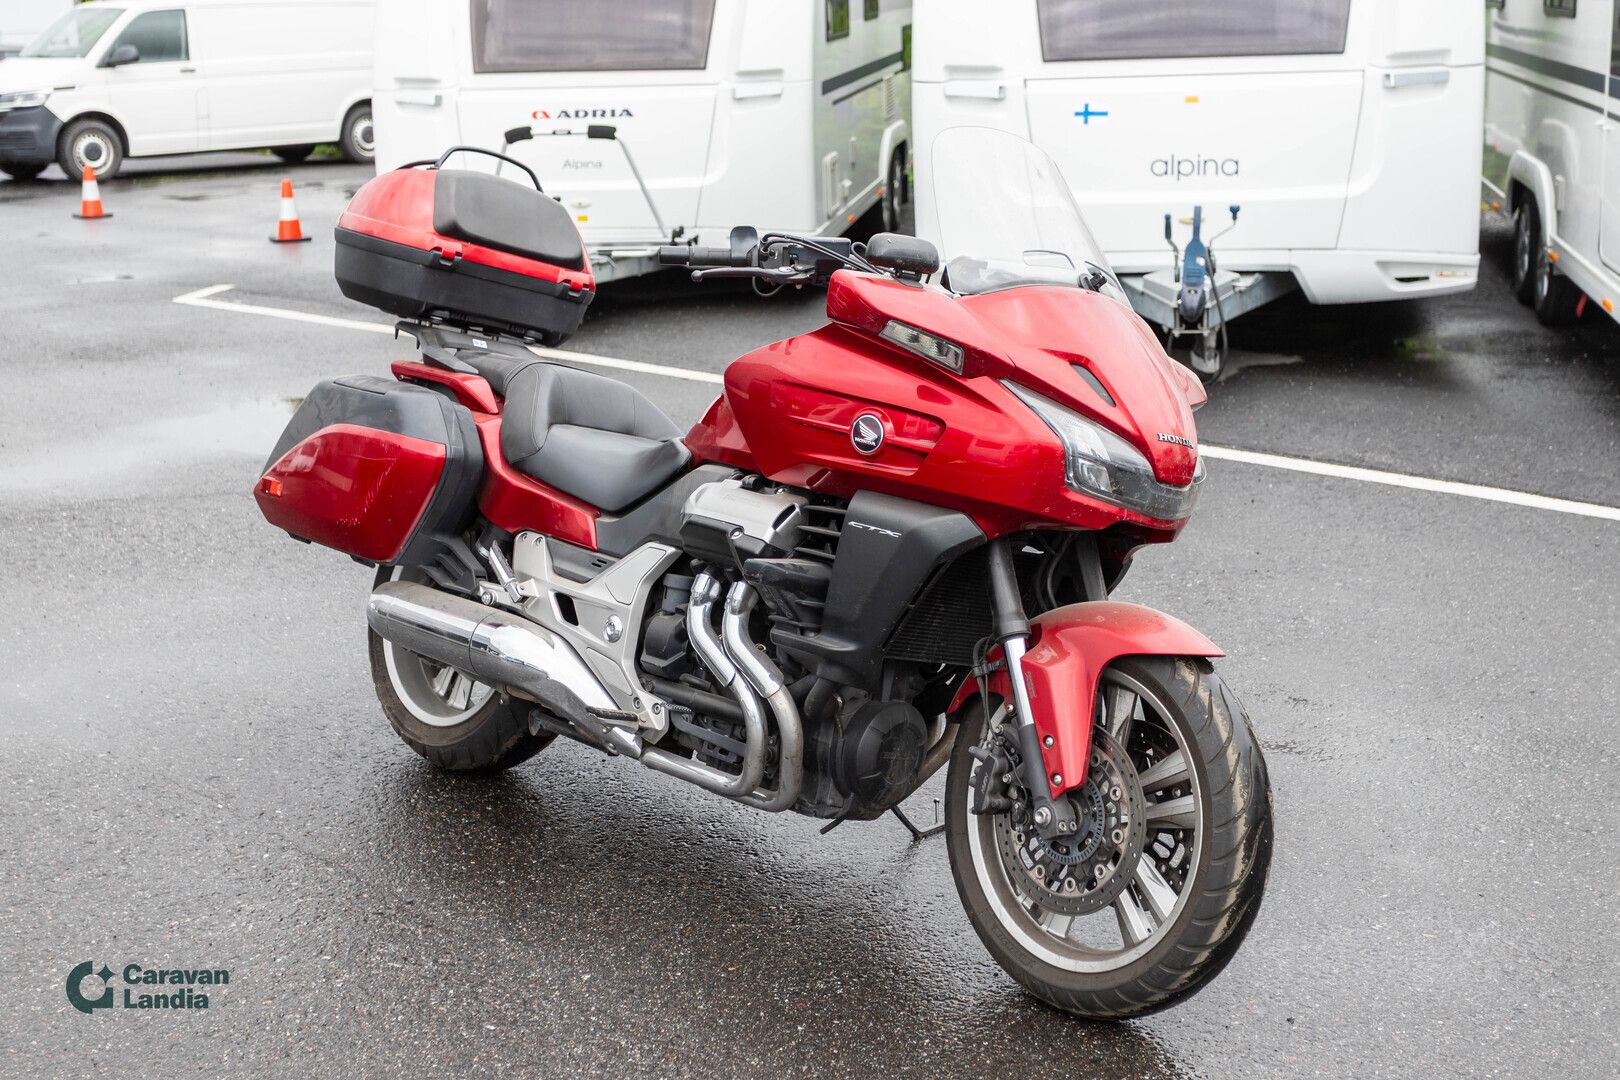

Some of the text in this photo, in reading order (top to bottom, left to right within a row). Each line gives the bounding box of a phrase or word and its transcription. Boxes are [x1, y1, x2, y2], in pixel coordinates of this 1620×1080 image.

[556, 109, 633, 119] ADRIA
[562, 159, 603, 170] Alpina
[1150, 153, 1239, 181] alpina
[1157, 432, 1194, 449] HONDA
[848, 521, 902, 537] CTX
